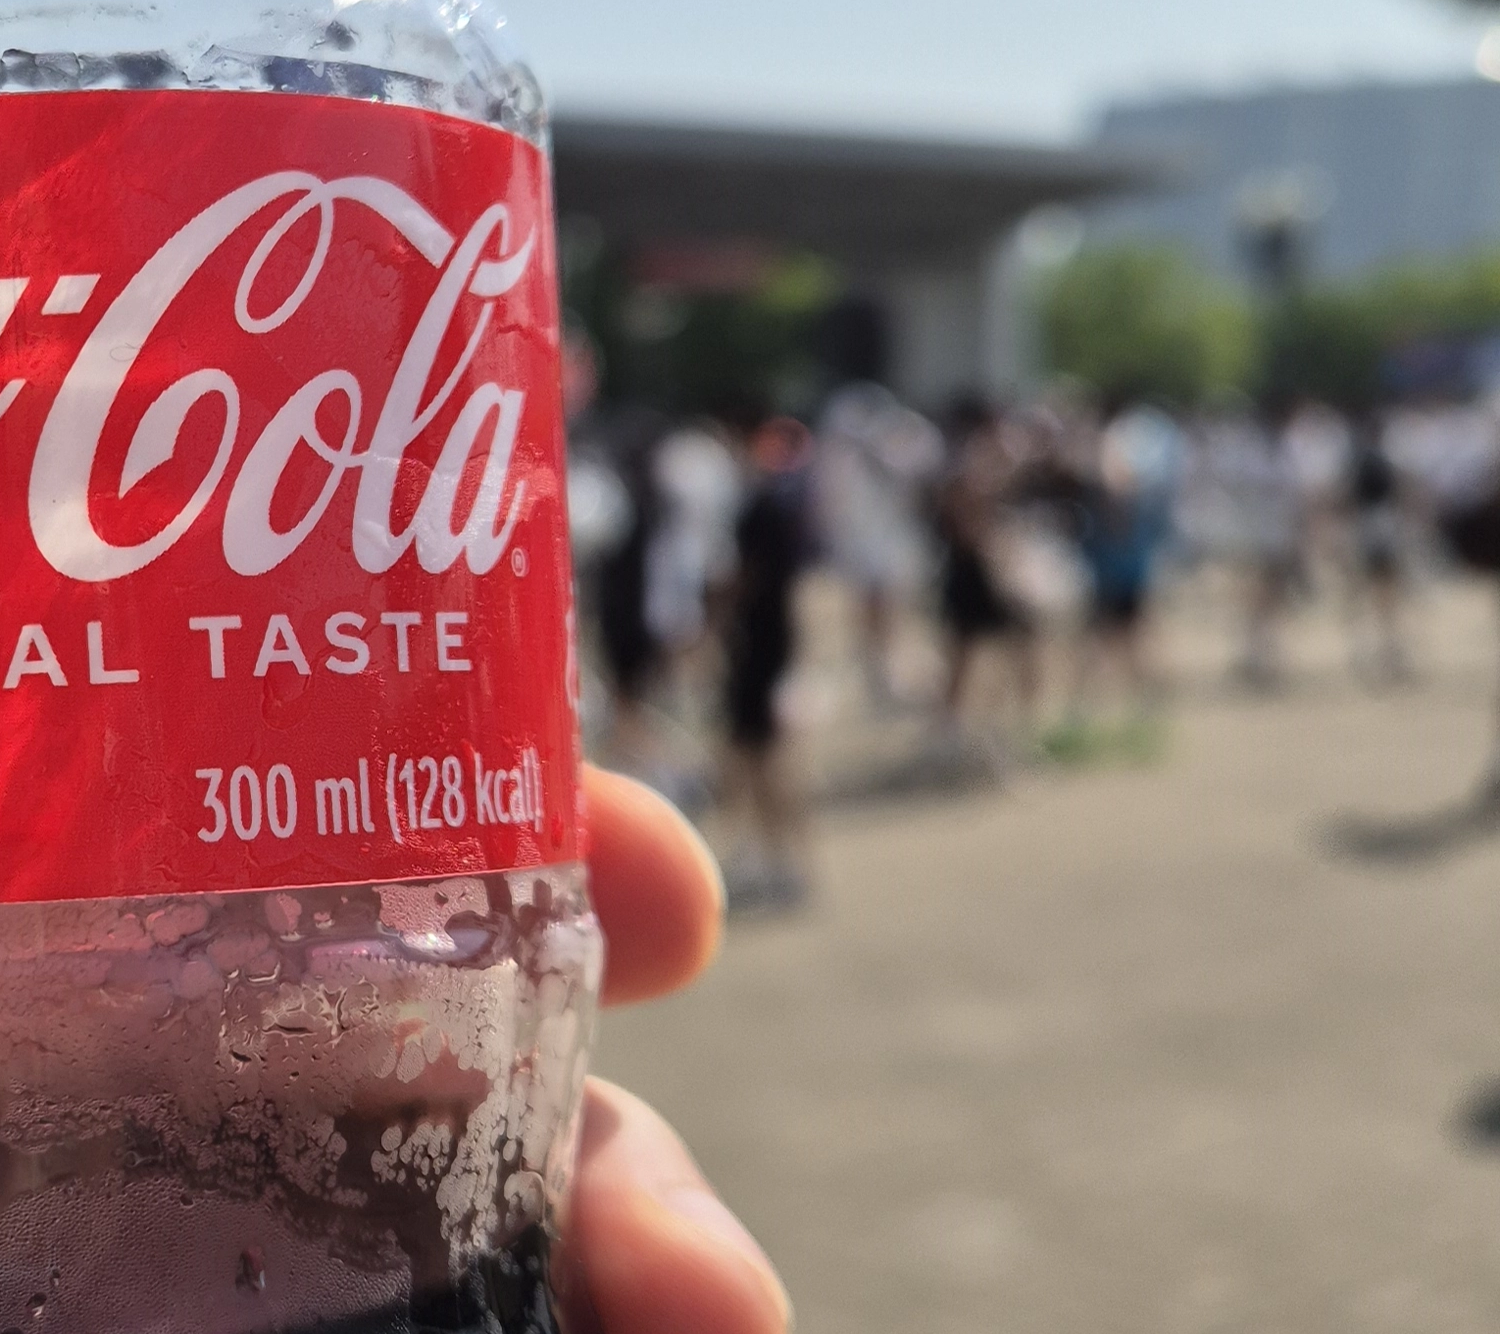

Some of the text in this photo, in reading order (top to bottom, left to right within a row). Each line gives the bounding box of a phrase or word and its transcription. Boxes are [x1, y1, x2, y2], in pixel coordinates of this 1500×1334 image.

[188, 610, 473, 679] TASTE
[195, 746, 544, 844] 300 ml (128 kcal)
